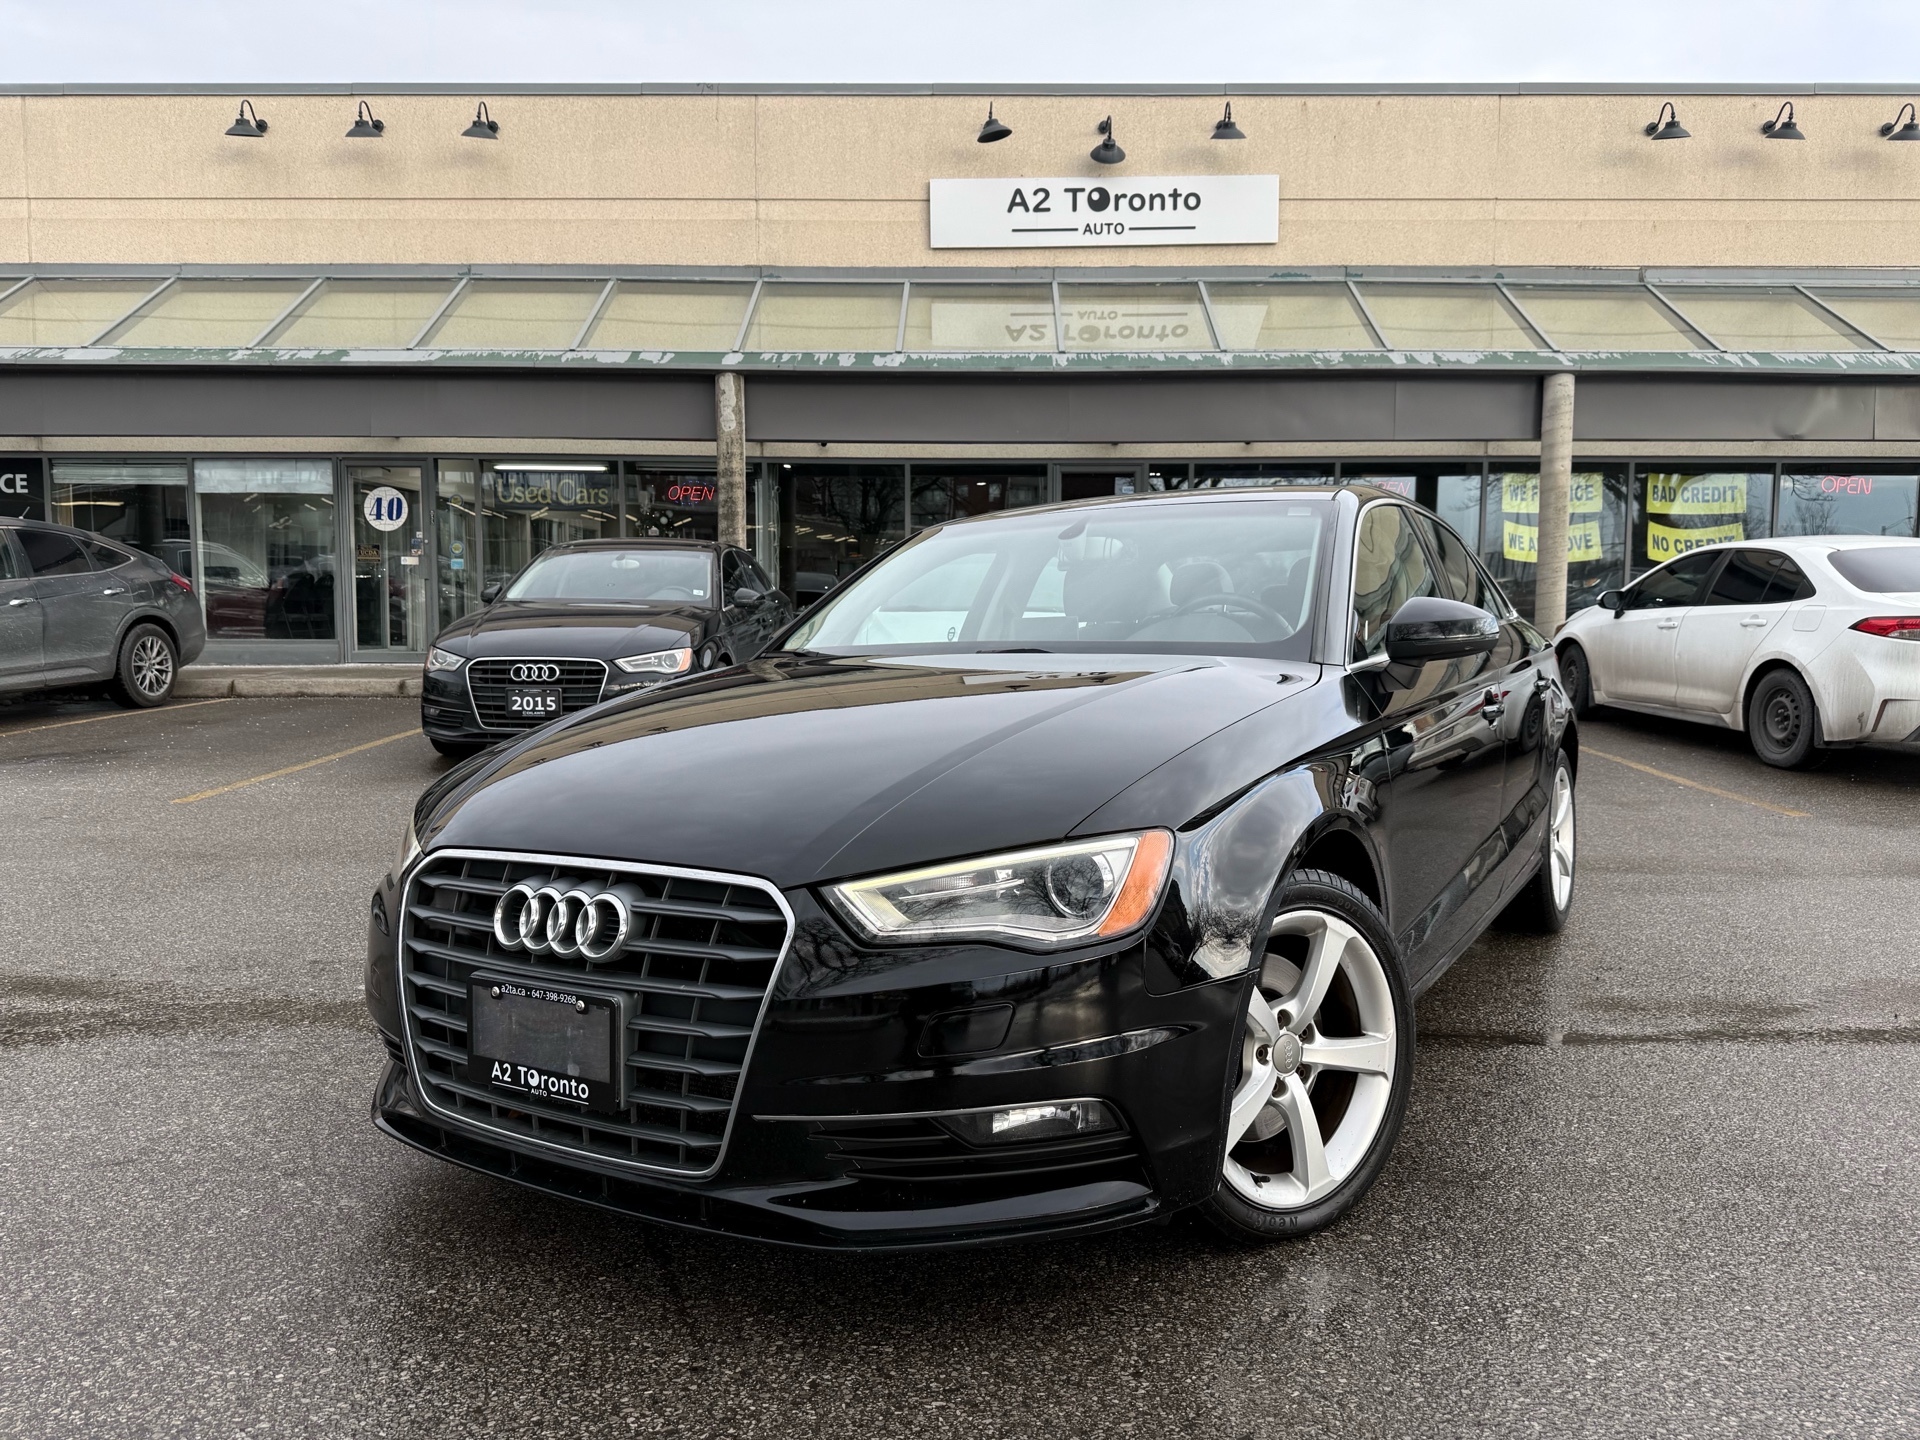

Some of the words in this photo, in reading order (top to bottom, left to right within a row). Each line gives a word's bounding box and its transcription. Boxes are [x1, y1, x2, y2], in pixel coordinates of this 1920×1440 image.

[1007, 187, 1051, 213] A2
[1082, 222, 1125, 236] AUTO
[497, 479, 552, 504] Used
[557, 479, 609, 505] Cars
[668, 485, 715, 501] OPEN
[1373, 480, 1411, 497] PEN
[1509, 484, 1527, 502] WE
[1652, 485, 1677, 503] BAD
[1681, 485, 1738, 504] CREDIT
[1821, 475, 1873, 495] OPEN
[369, 497, 403, 521] 40
[1508, 532, 1525, 551] WE
[1652, 534, 1670, 553] NO
[511, 696, 556, 711] 2015
[501, 984, 526, 996] a2ta.ca
[531, 989, 577, 1005] 647-398-9268
[491, 1061, 512, 1082] A2
[530, 1087, 548, 1097] AUTO
